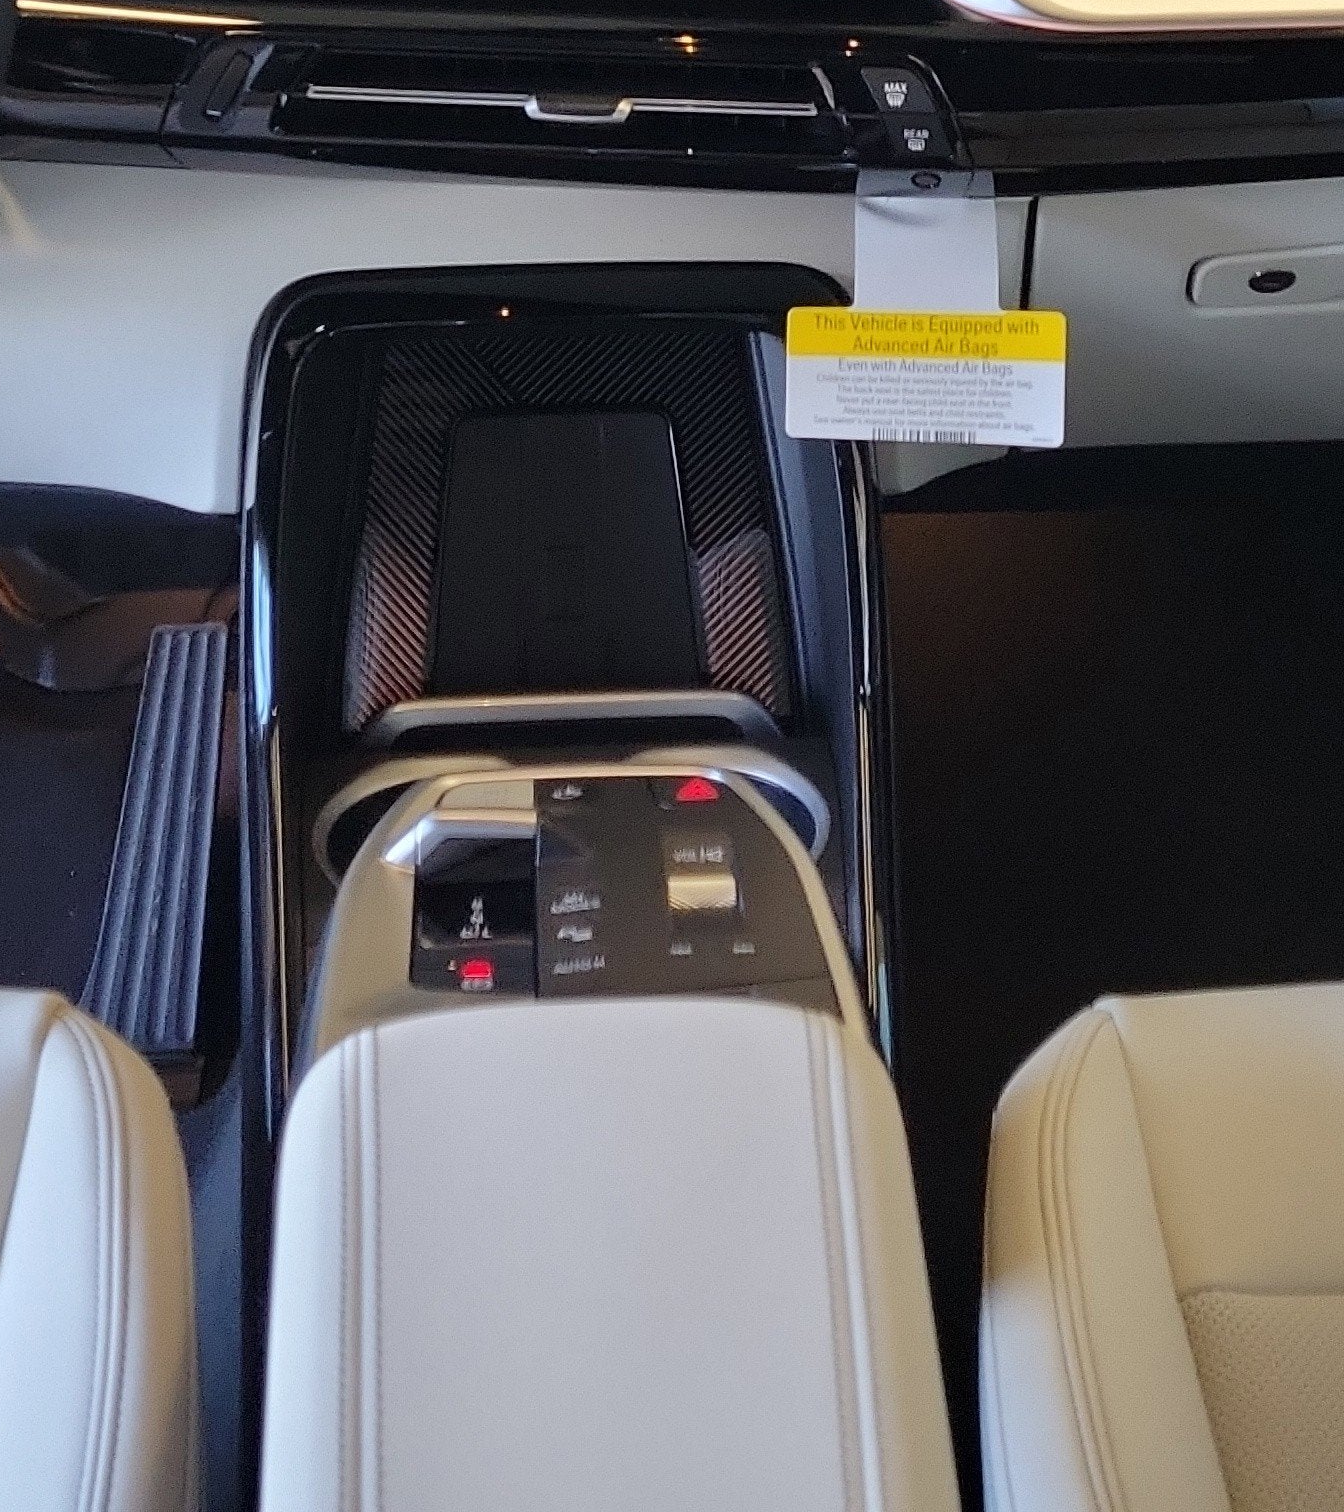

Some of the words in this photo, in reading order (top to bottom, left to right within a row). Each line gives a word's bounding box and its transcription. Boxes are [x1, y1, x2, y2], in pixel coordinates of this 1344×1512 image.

[884, 82, 908, 94] MAX
[903, 128, 930, 140] REAR
[815, 313, 845, 330] This
[850, 314, 907, 331] Vehicle
[912, 316, 923, 331] is
[929, 315, 1003, 336] Equipped
[1006, 320, 1040, 335] with
[852, 335, 929, 353] Advanced
[933, 337, 954, 354] Air
[960, 338, 999, 358] Bags
[838, 357, 868, 371] Even
[870, 358, 896, 372] with
[899, 358, 959, 374] Advanced
[962, 361, 979, 373] Air
[982, 361, 1013, 378] Bags
